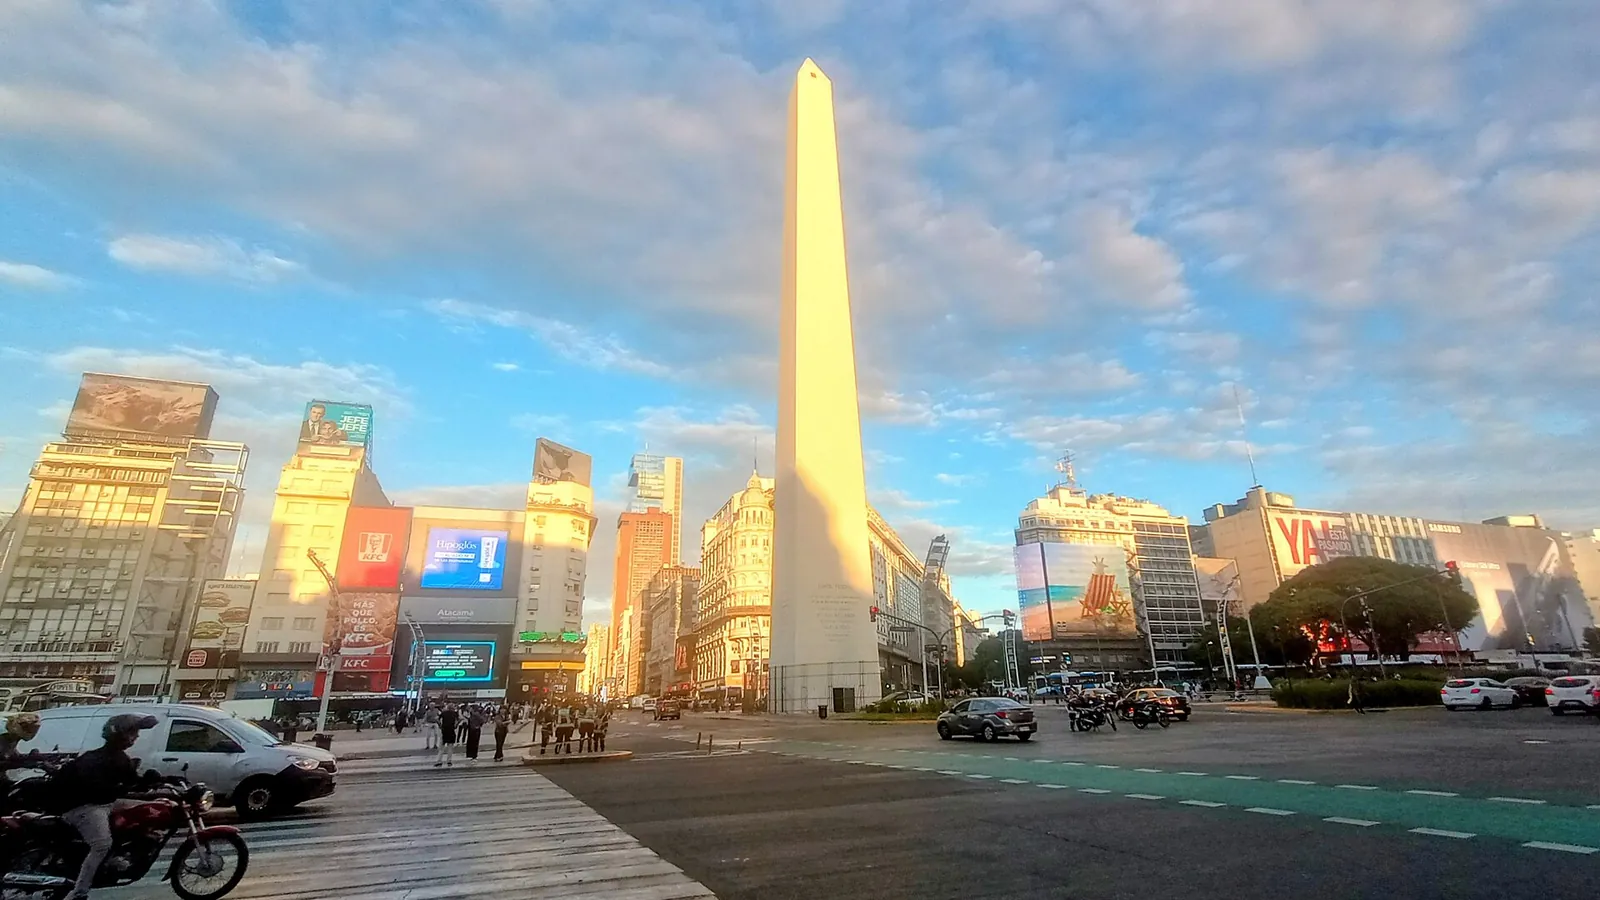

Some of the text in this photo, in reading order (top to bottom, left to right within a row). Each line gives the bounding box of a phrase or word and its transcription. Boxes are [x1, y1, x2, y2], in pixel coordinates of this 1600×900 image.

[340, 415, 368, 425] JEFE
[339, 423, 367, 432] JEFE
[1428, 523, 1461, 533] SAMSUNG
[1330, 528, 1349, 540] ESTÁ
[436, 539, 477, 550] Hipoglós
[1318, 539, 1351, 551] PASANDO
[362, 553, 383, 561] KFC
[352, 609, 372, 617] QUE
[437, 608, 474, 616] Atacama
[343, 617, 379, 625] POLLO,
[343, 632, 375, 643] KFC
[343, 659, 369, 668] KFC
